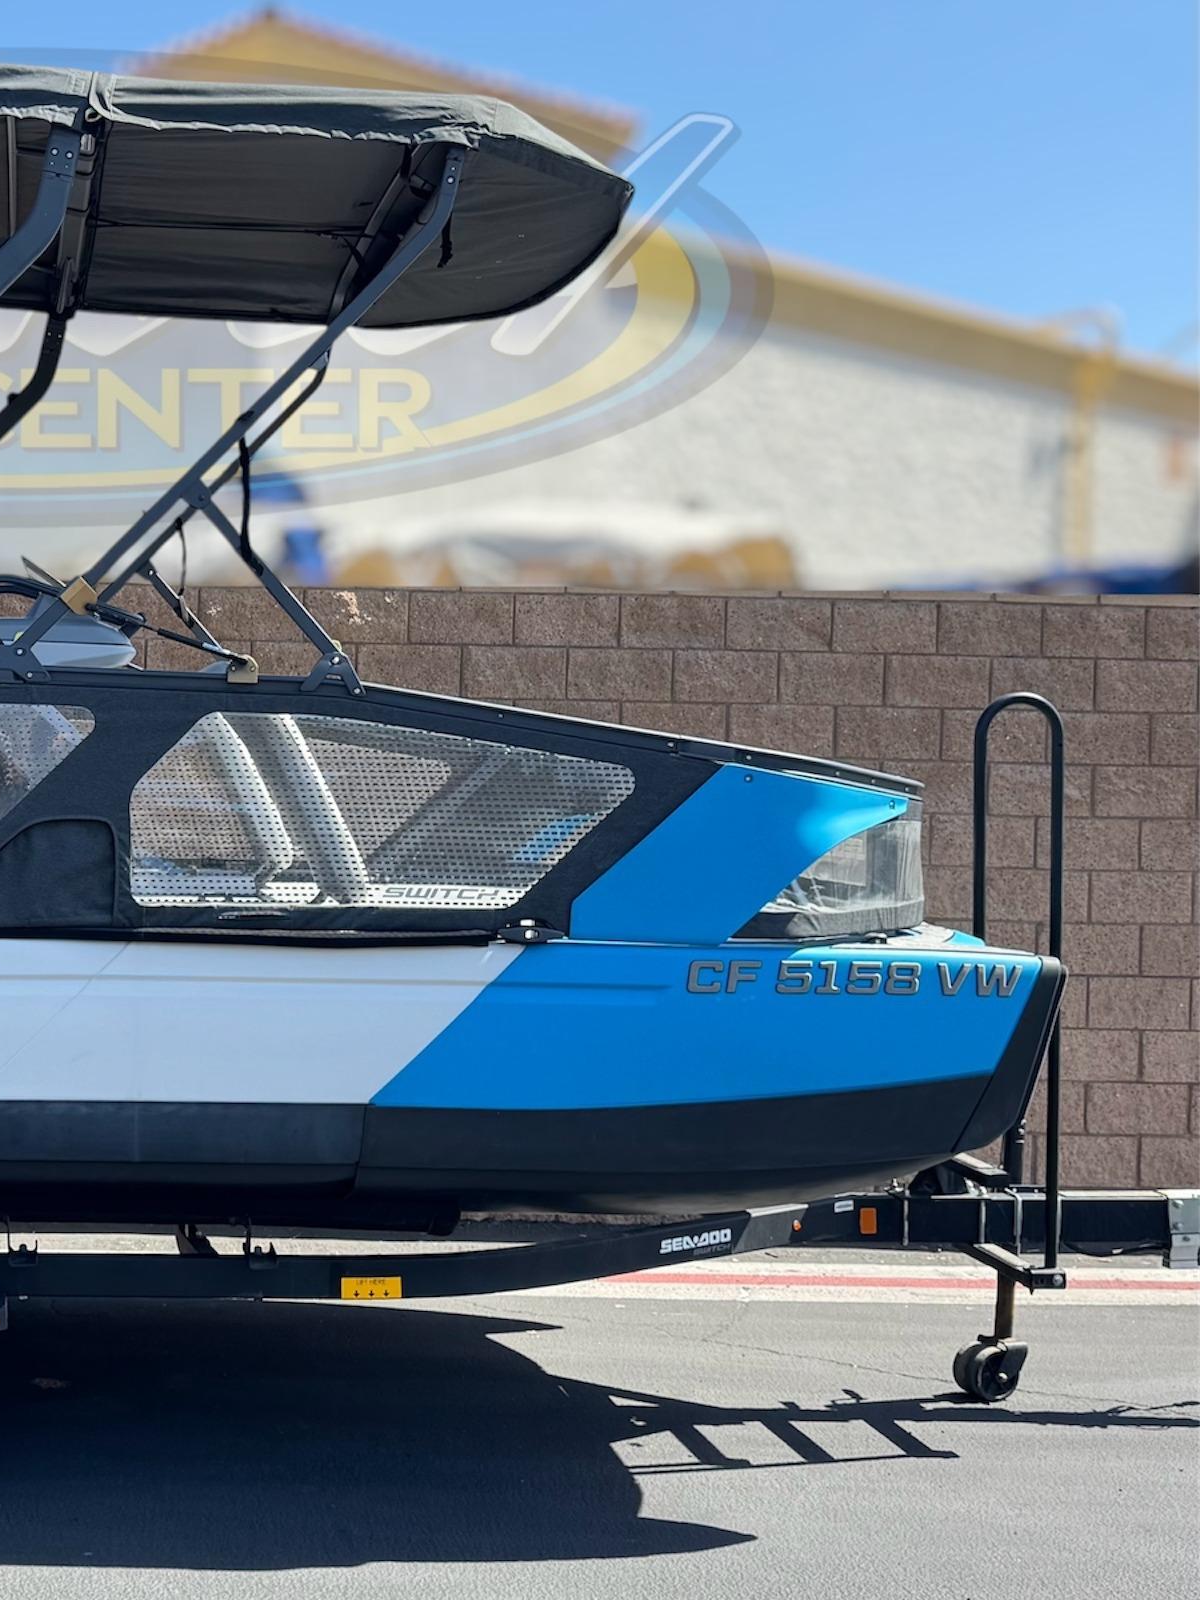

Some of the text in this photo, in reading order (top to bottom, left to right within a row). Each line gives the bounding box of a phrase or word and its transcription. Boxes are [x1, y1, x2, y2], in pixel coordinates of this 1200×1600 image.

[382, 887, 500, 900] SWITCH
[687, 959, 1023, 997] CF 5158 VW
